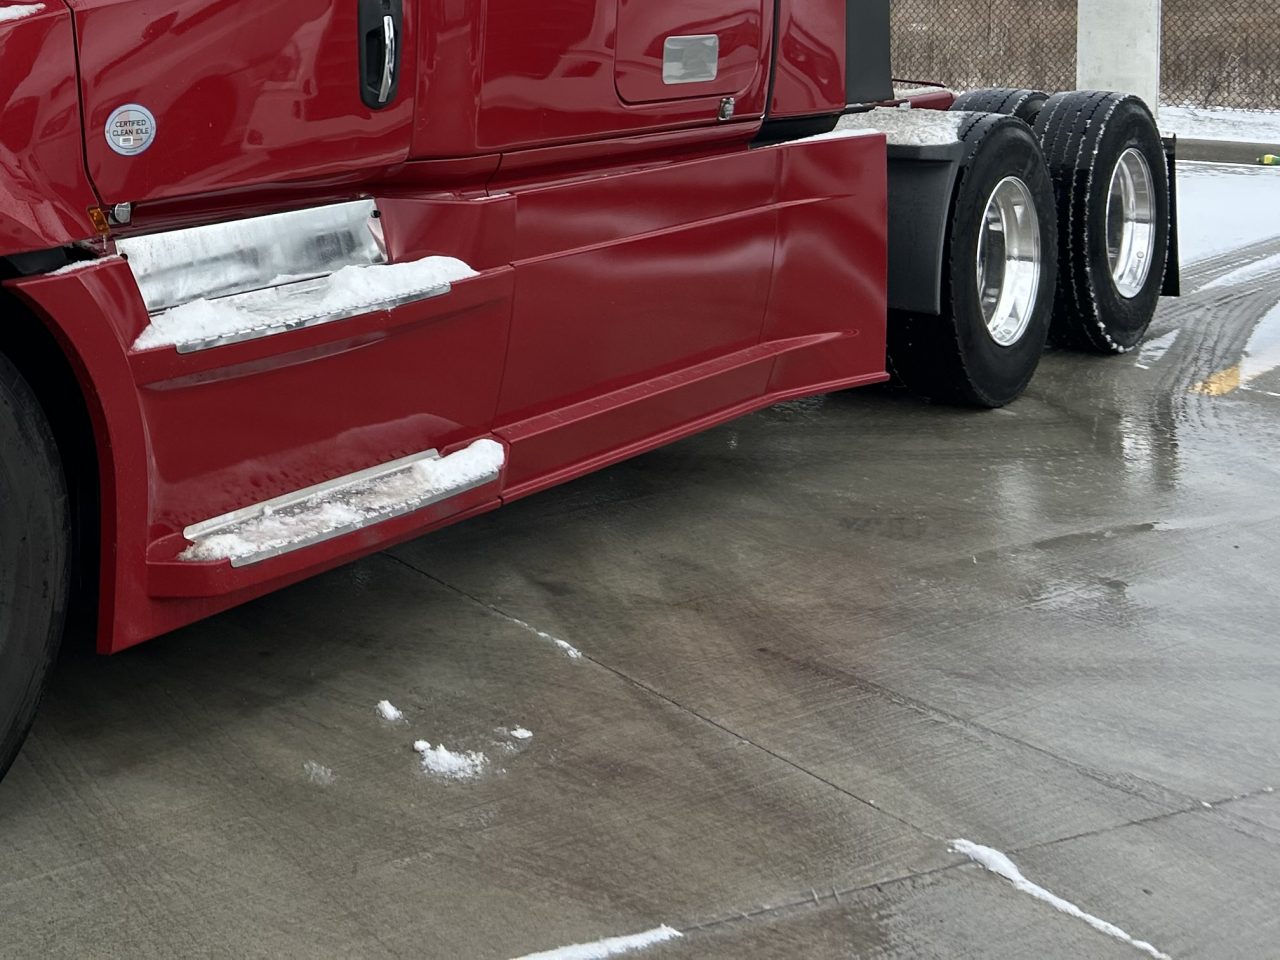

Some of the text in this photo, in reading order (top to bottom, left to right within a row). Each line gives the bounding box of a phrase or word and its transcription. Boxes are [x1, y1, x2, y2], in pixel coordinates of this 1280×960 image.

[115, 119, 147, 128] CERTIFIED
[112, 127, 150, 137] CLEAN IDLE
